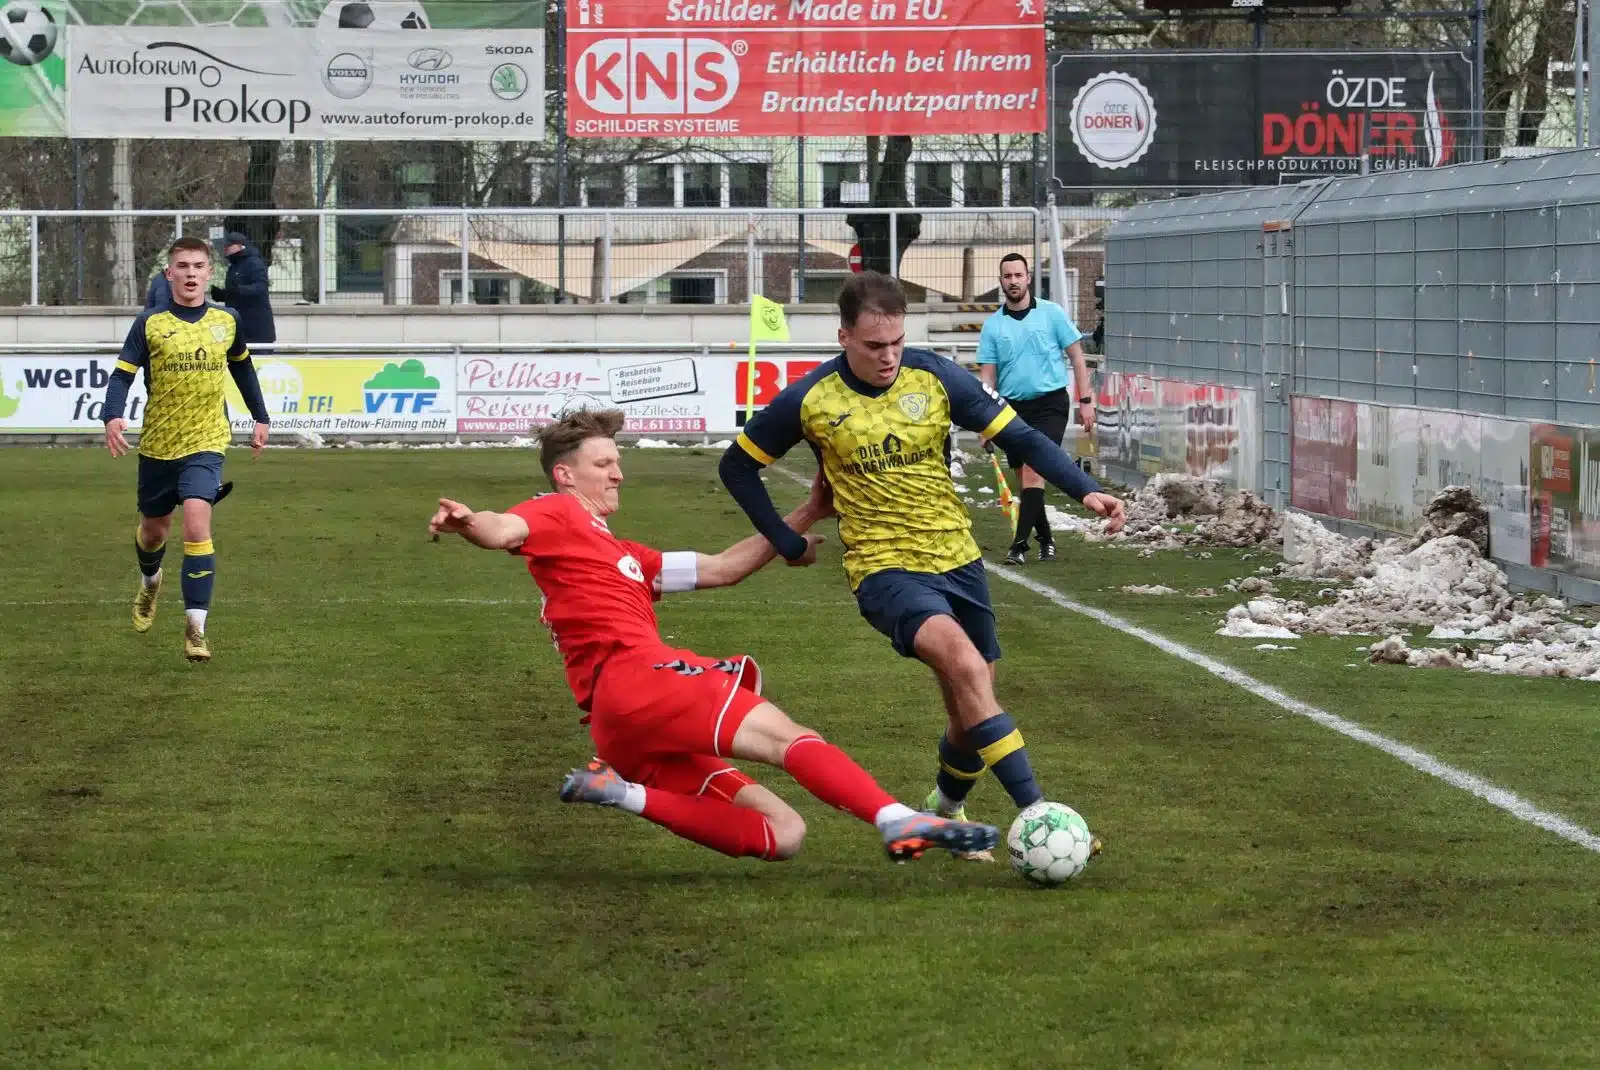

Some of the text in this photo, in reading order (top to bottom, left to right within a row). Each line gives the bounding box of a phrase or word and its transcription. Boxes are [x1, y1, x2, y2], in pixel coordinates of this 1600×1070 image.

[666, 0, 948, 22] Schilder. Made in EU.
[485, 44, 534, 55] ŠKODA
[767, 49, 1031, 74] Erhältlich bei Ihrem
[329, 69, 367, 78] VOLVO
[400, 74, 460, 84] HYUNDAI
[585, 52, 728, 102] KNS
[1326, 69, 1406, 107] ÖZDE
[761, 88, 1039, 118] Brandschutzpartner!
[1103, 102, 1129, 114] ÖZDE
[321, 112, 534, 128] www.autoforum-prokop.de
[575, 119, 740, 133] SCHILDER SYSTEME
[1084, 112, 1133, 129] DÖNER
[1263, 102, 1417, 156] DÖNER
[1195, 159, 1418, 171] FLEISCHPRODUKTION GMBH
[179, 352, 193, 360] DIE
[619, 366, 662, 378] Busbetrieb
[620, 376, 661, 388] Reisebüro
[622, 382, 692, 397] Reiseveranstalter
[282, 395, 334, 413] in TF!
[364, 392, 437, 413] VTF
[466, 396, 549, 417] Reisen
[694, 405, 701, 416] 2
[421, 418, 447, 430] mbH
[860, 444, 881, 459] DIE
